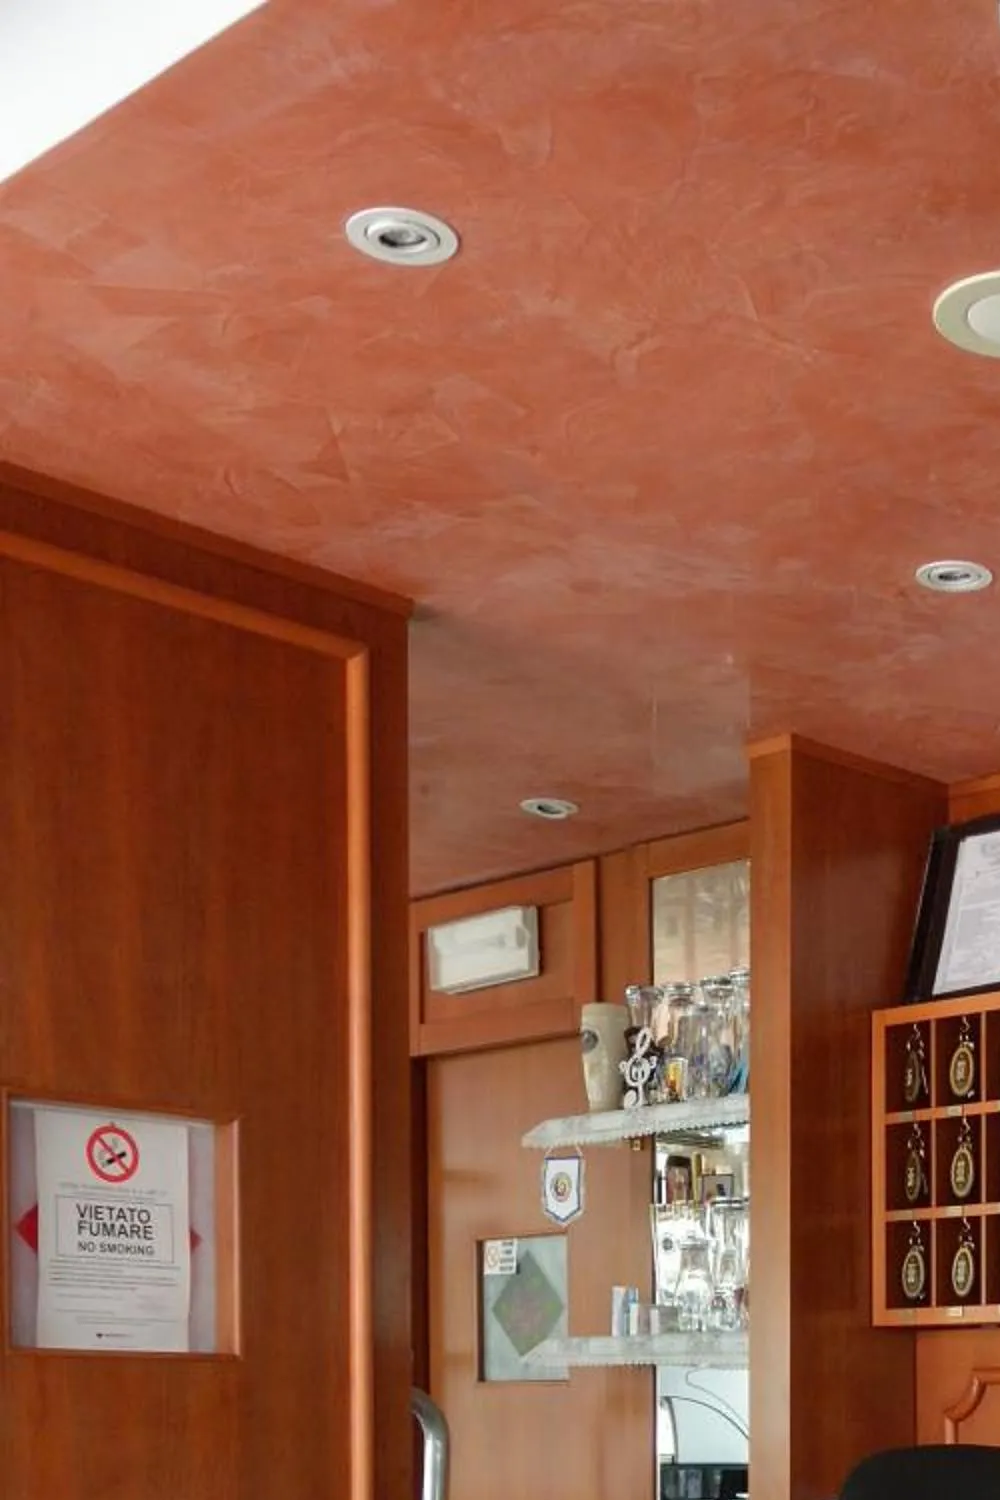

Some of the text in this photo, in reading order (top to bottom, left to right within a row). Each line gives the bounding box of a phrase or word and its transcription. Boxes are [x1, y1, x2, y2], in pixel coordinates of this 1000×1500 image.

[76, 1203, 151, 1224] VIETATO
[77, 1219, 155, 1241] FUMARE
[77, 1240, 156, 1256] NO SMOKING
